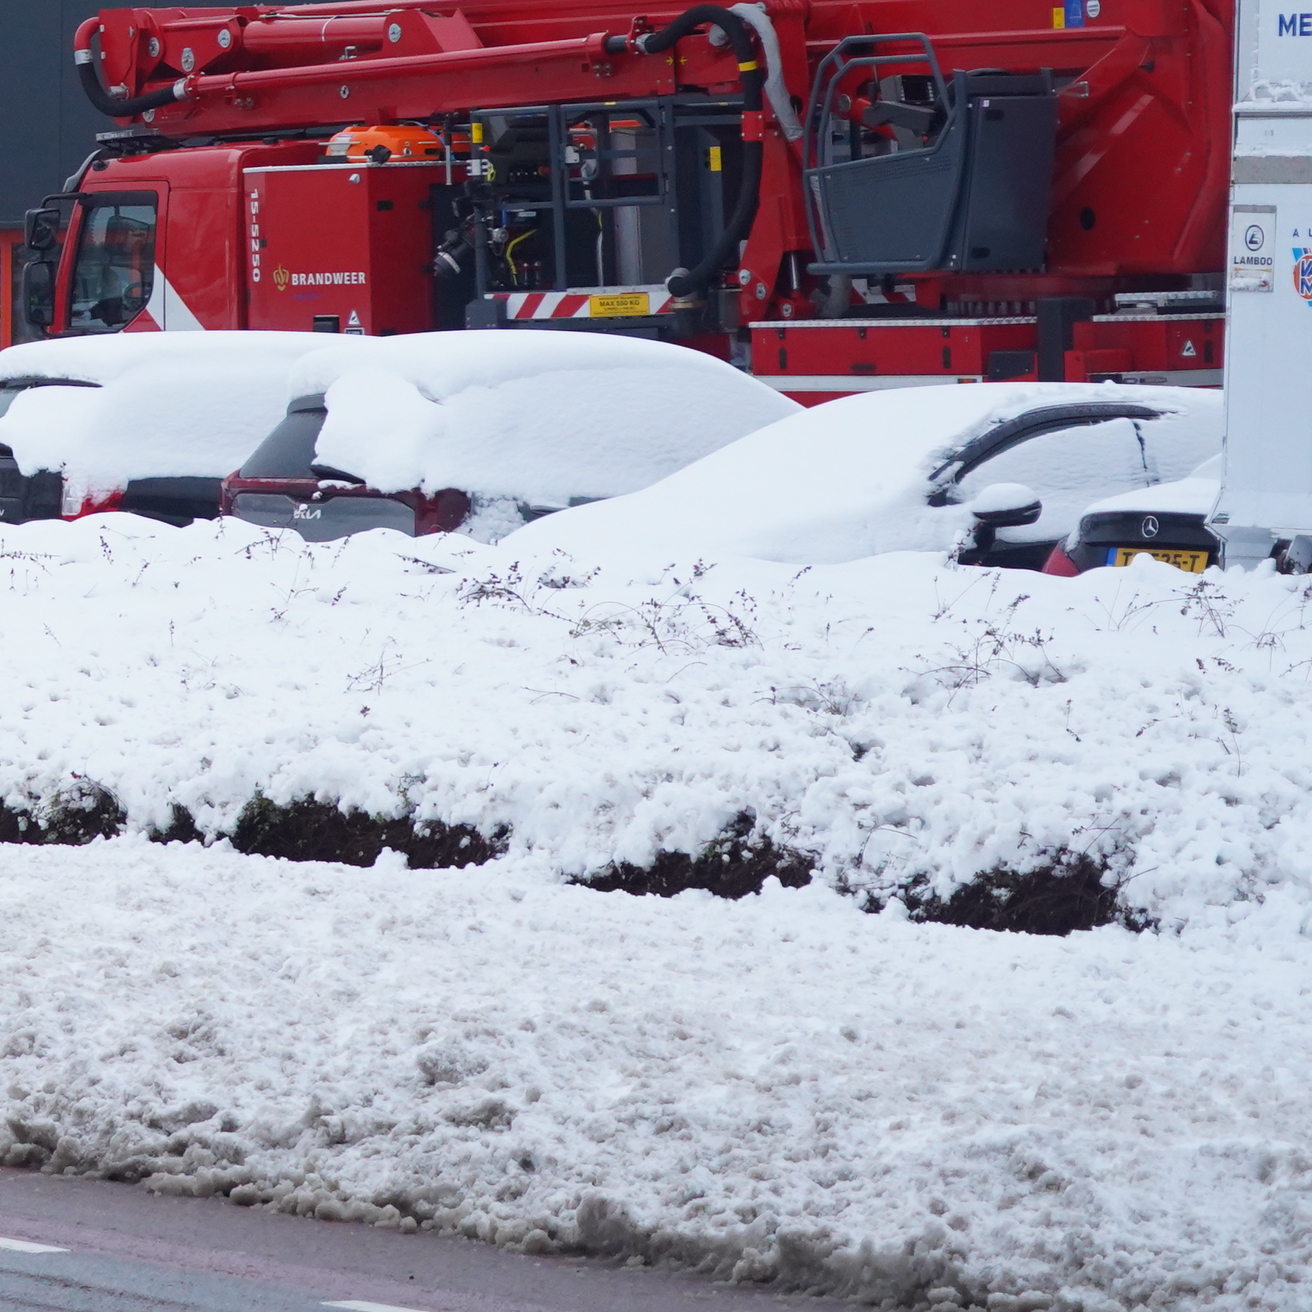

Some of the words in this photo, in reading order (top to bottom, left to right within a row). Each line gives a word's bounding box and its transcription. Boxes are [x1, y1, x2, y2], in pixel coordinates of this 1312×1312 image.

[250, 188, 261, 283] 15-5250
[1233, 255, 1273, 266] LAMBOO
[291, 271, 366, 286] BRANDWEER
